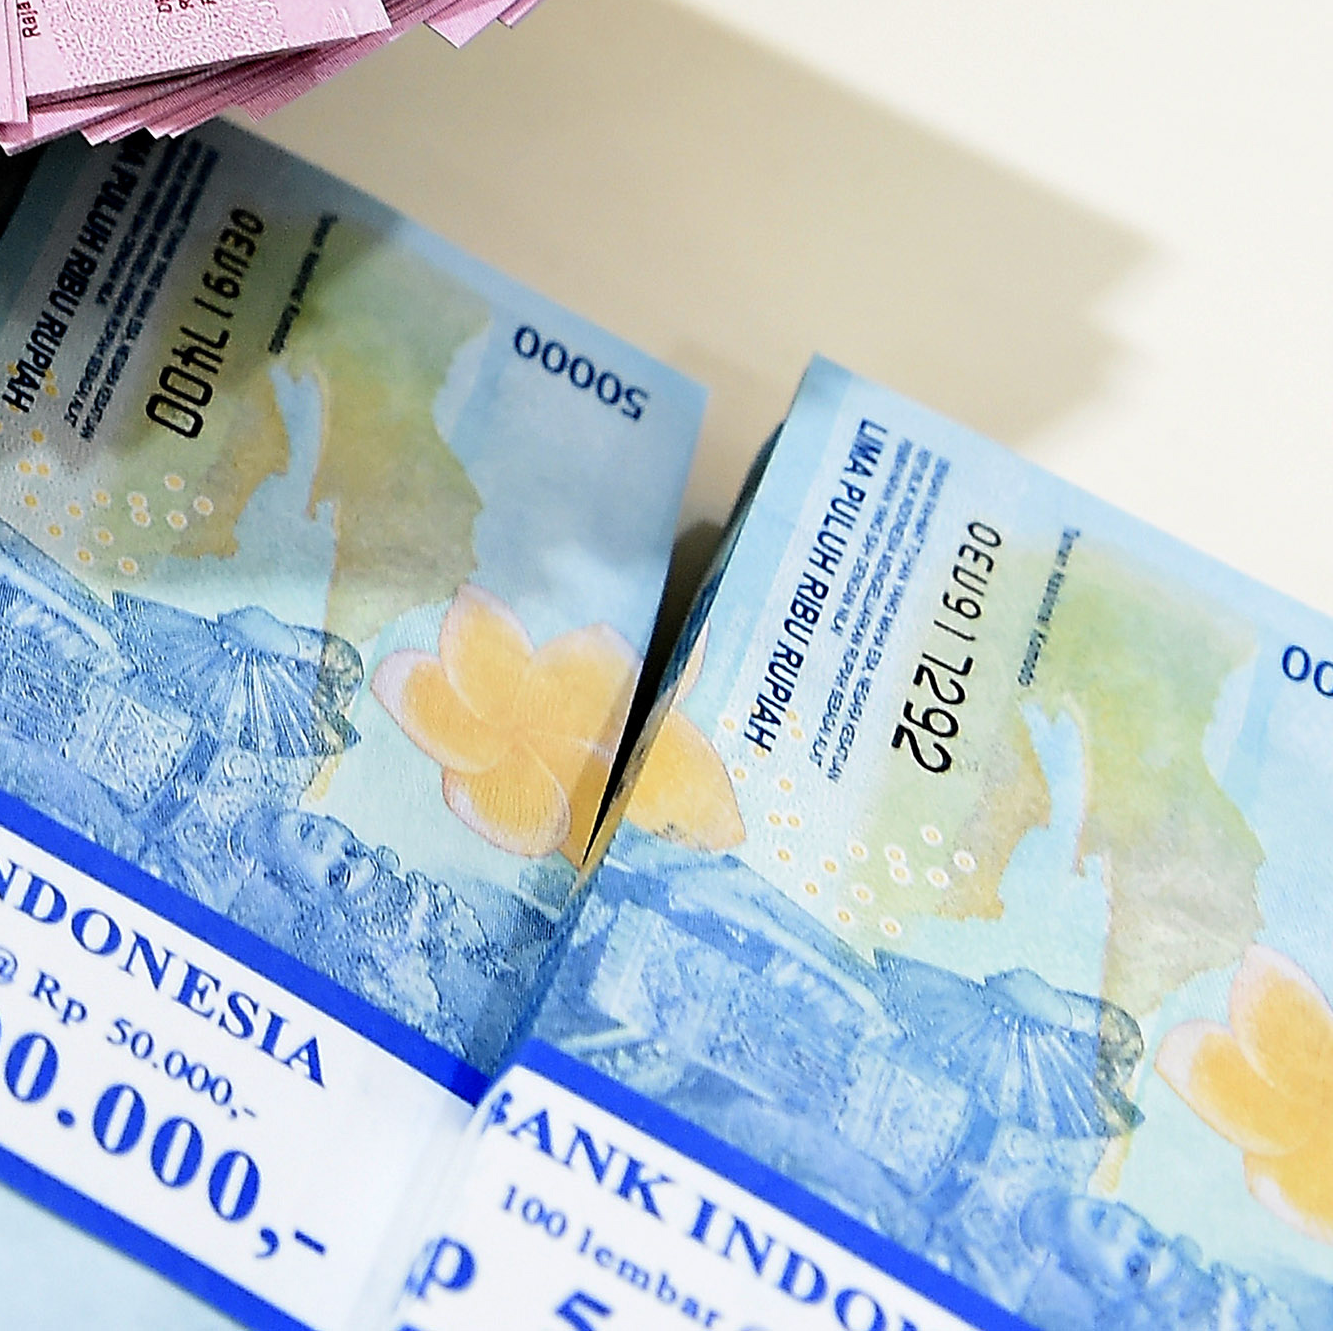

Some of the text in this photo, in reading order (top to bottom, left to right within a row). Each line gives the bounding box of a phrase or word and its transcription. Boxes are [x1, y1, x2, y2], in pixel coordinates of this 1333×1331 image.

[15, 0, 41, 42] Raja
[47, 245, 98, 317] RIBU
[0, 306, 69, 413] RUPIAH
[512, 324, 648, 421] 50000
[742, 418, 887, 752] LIMA PULUH RIBU RUPIAH
[31, 970, 87, 1025] Rp
[106, 1017, 255, 1118] 50.000,-
[501, 1184, 721, 1331] 100 lembar
